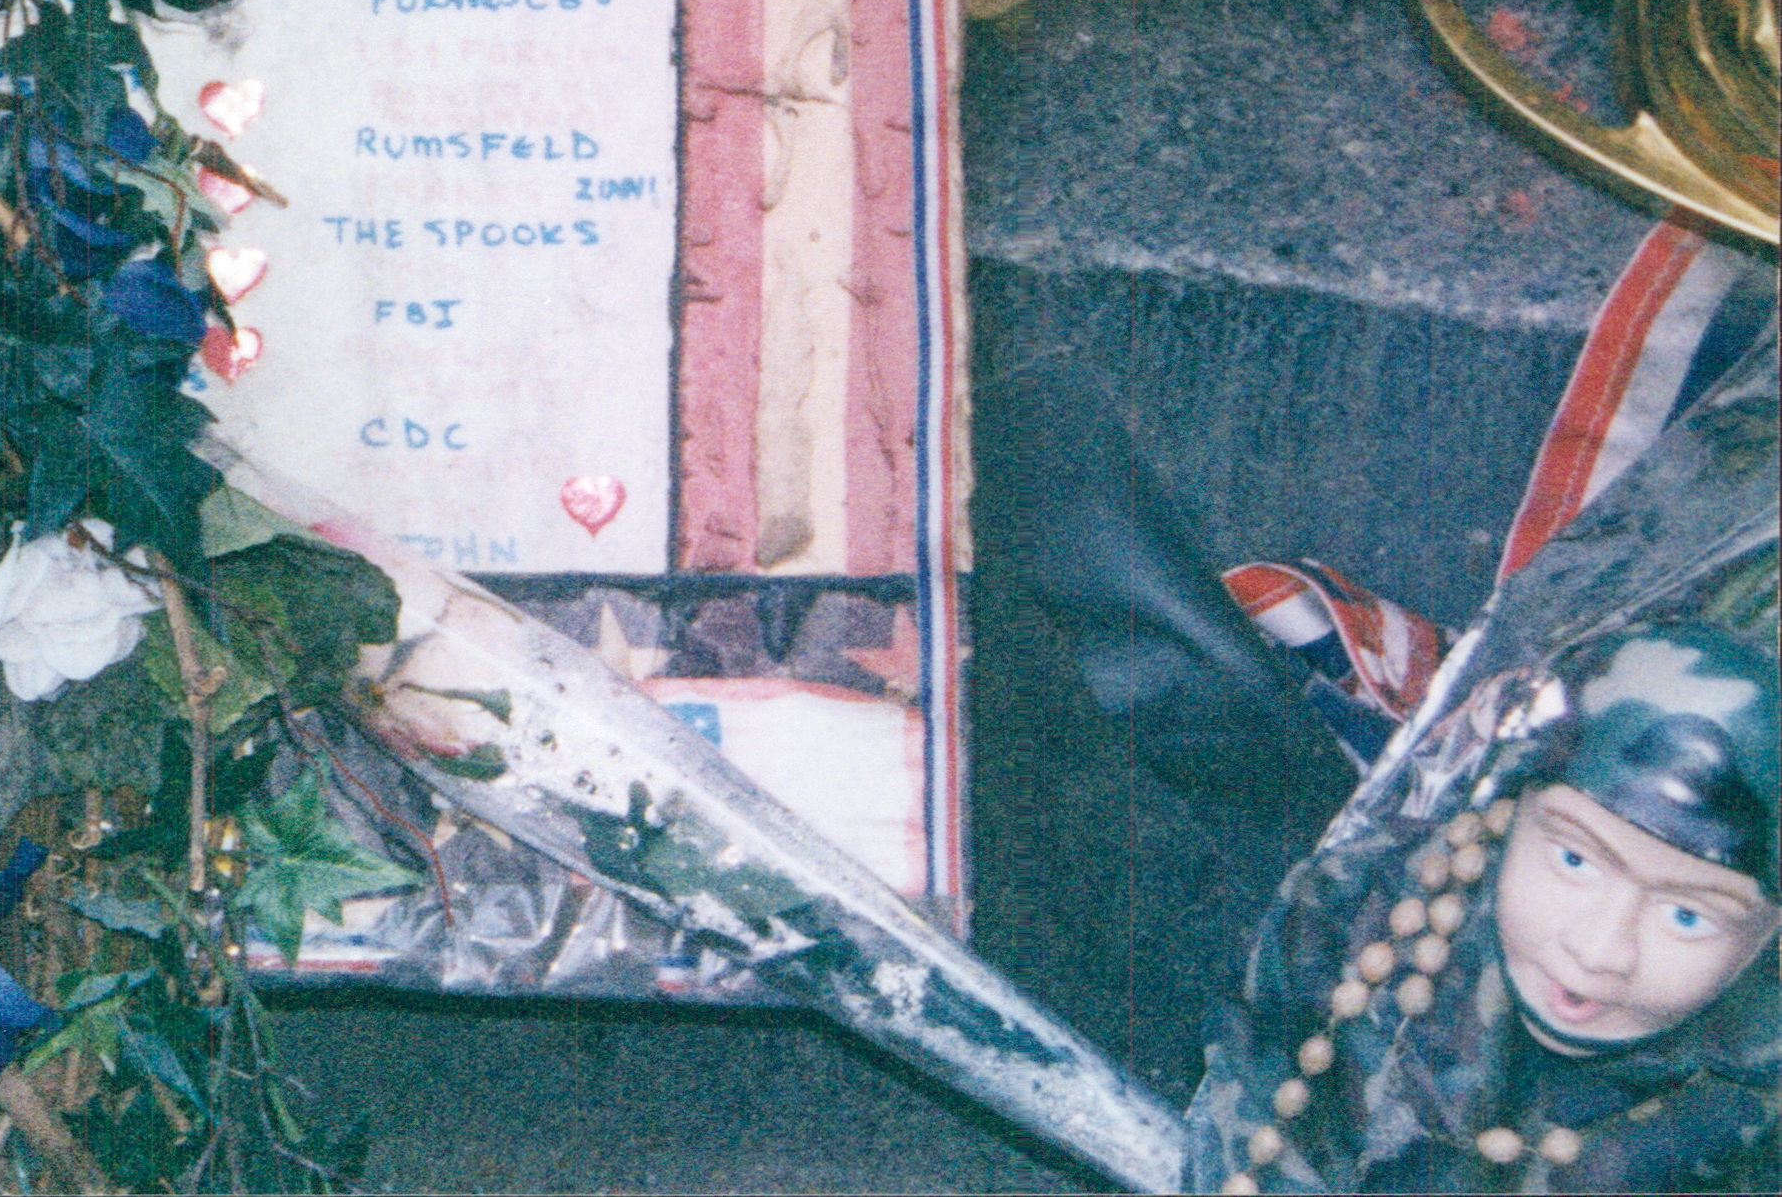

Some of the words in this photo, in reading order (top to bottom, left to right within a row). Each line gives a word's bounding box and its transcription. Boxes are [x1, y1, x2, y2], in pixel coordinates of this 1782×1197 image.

[321, 214, 405, 251] THE
[422, 218, 602, 248] SPOOKS
[373, 298, 464, 330] FBI
[357, 416, 468, 451] CDC
